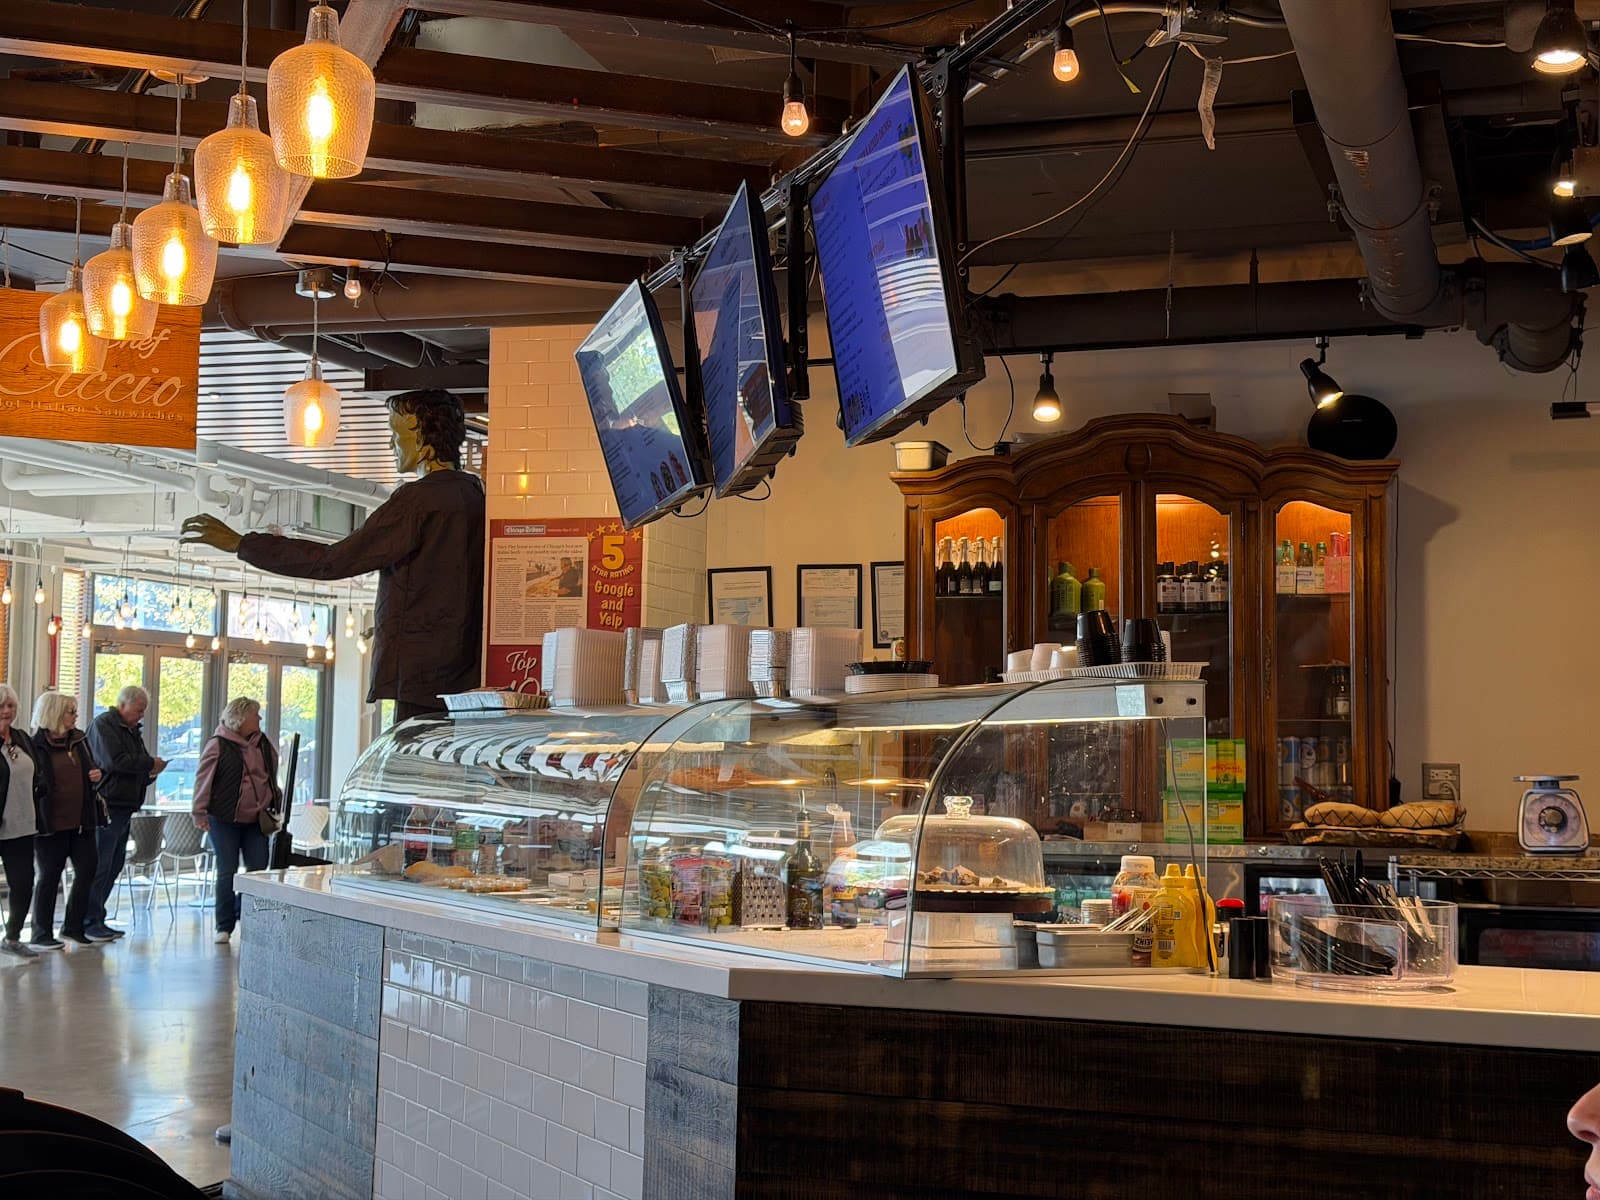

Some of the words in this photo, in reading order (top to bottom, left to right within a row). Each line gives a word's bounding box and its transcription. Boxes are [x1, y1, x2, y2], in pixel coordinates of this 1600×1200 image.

[601, 536, 625, 570] 5
[591, 565, 609, 579] STAR
[609, 564, 635, 579] RATING
[594, 579, 634, 598] Google
[600, 597, 625, 612] and
[599, 611, 623, 629] Yelp
[505, 649, 537, 680] Top
